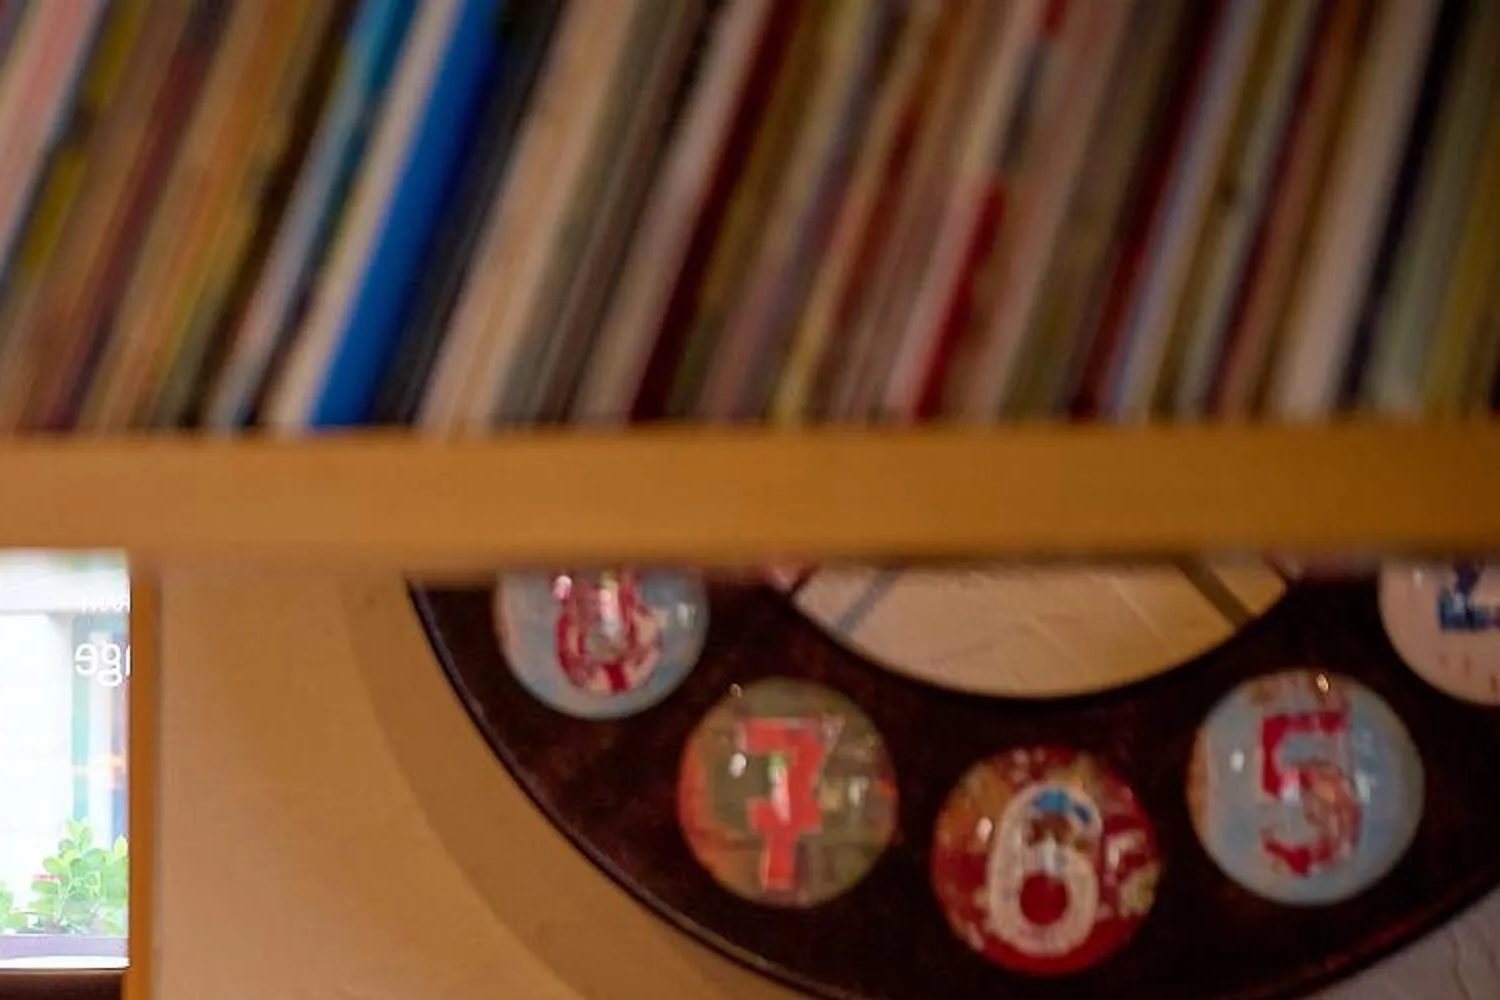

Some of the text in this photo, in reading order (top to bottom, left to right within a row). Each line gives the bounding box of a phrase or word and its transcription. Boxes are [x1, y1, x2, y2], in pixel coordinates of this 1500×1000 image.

[736, 714, 845, 890] 7
[987, 780, 1103, 957] 6
[1258, 710, 1364, 878] 5
